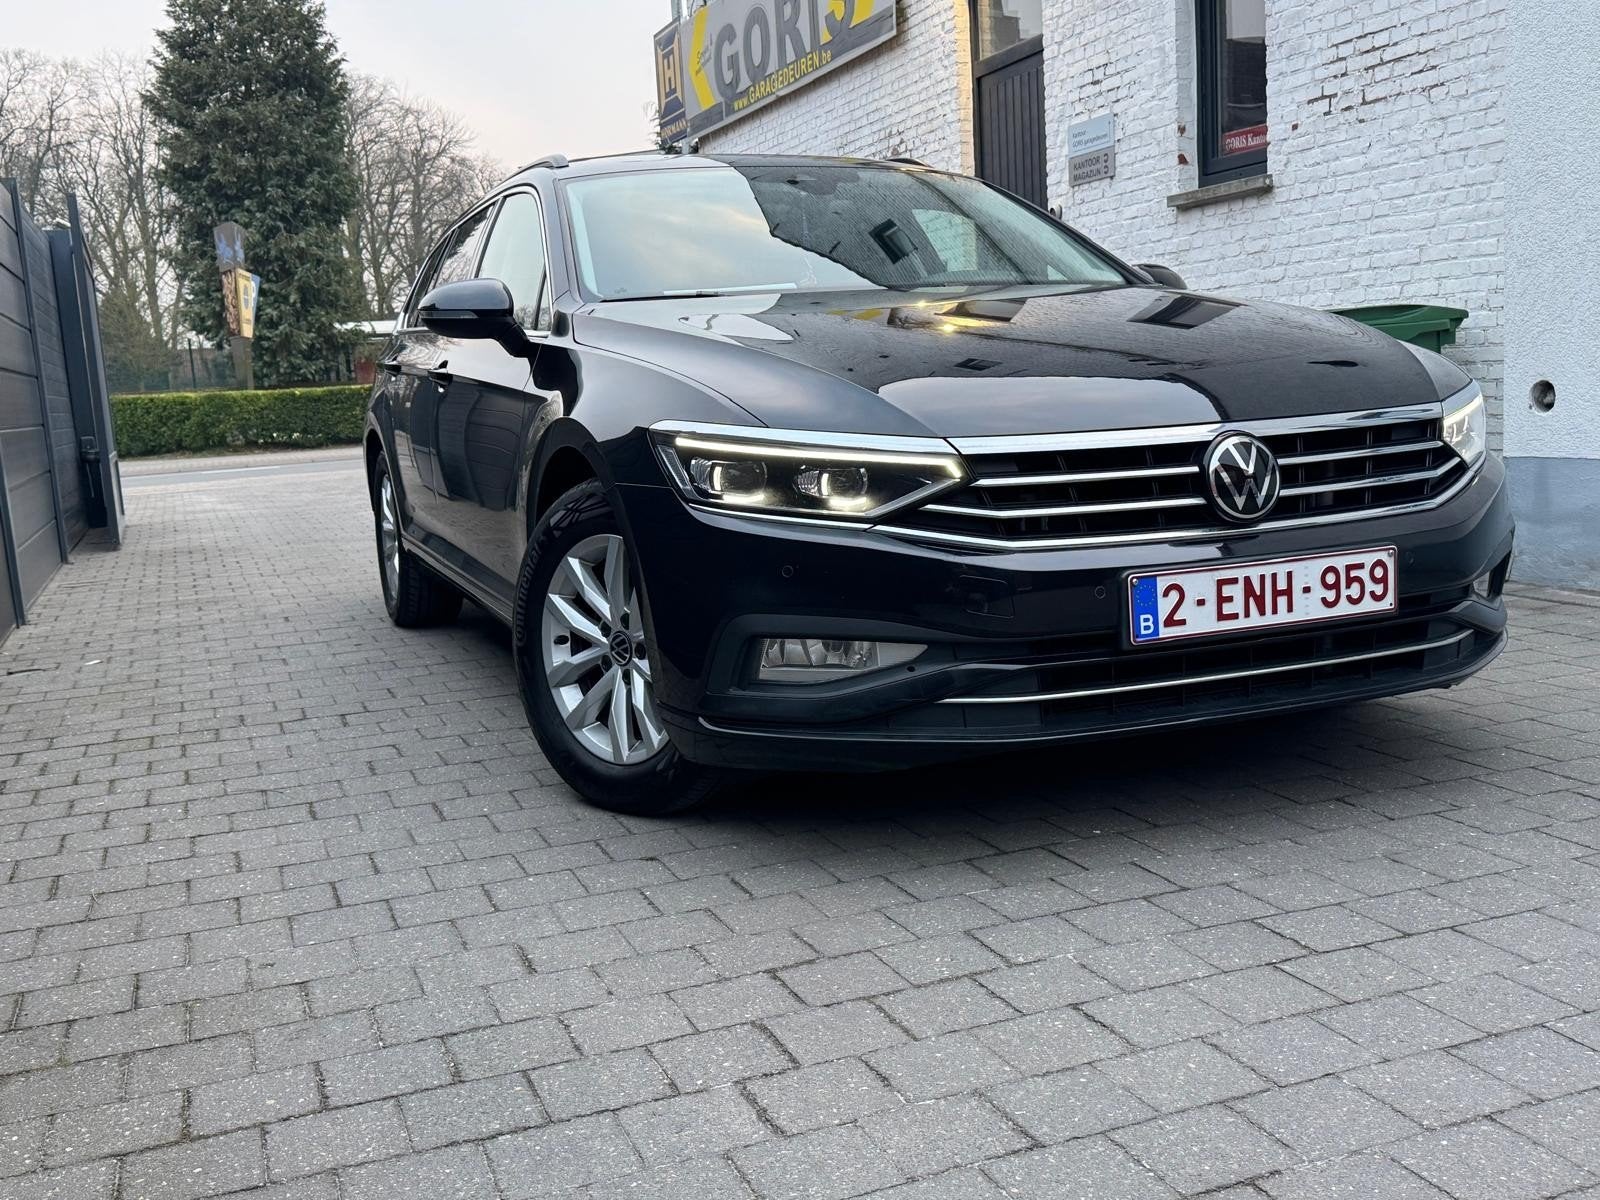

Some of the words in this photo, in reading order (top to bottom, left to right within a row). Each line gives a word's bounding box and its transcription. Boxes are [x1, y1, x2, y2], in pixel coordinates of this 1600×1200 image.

[714, 0, 854, 99] GORIS
[733, 50, 832, 111] www.GARAGEDEUREN.be
[1225, 135, 1246, 151] GORIS
[1073, 155, 1101, 171] KANTOOR
[1073, 167, 1101, 182] MAGAZIJN
[1161, 558, 1390, 628] 2-ENH-959
[1139, 613, 1155, 635] B
